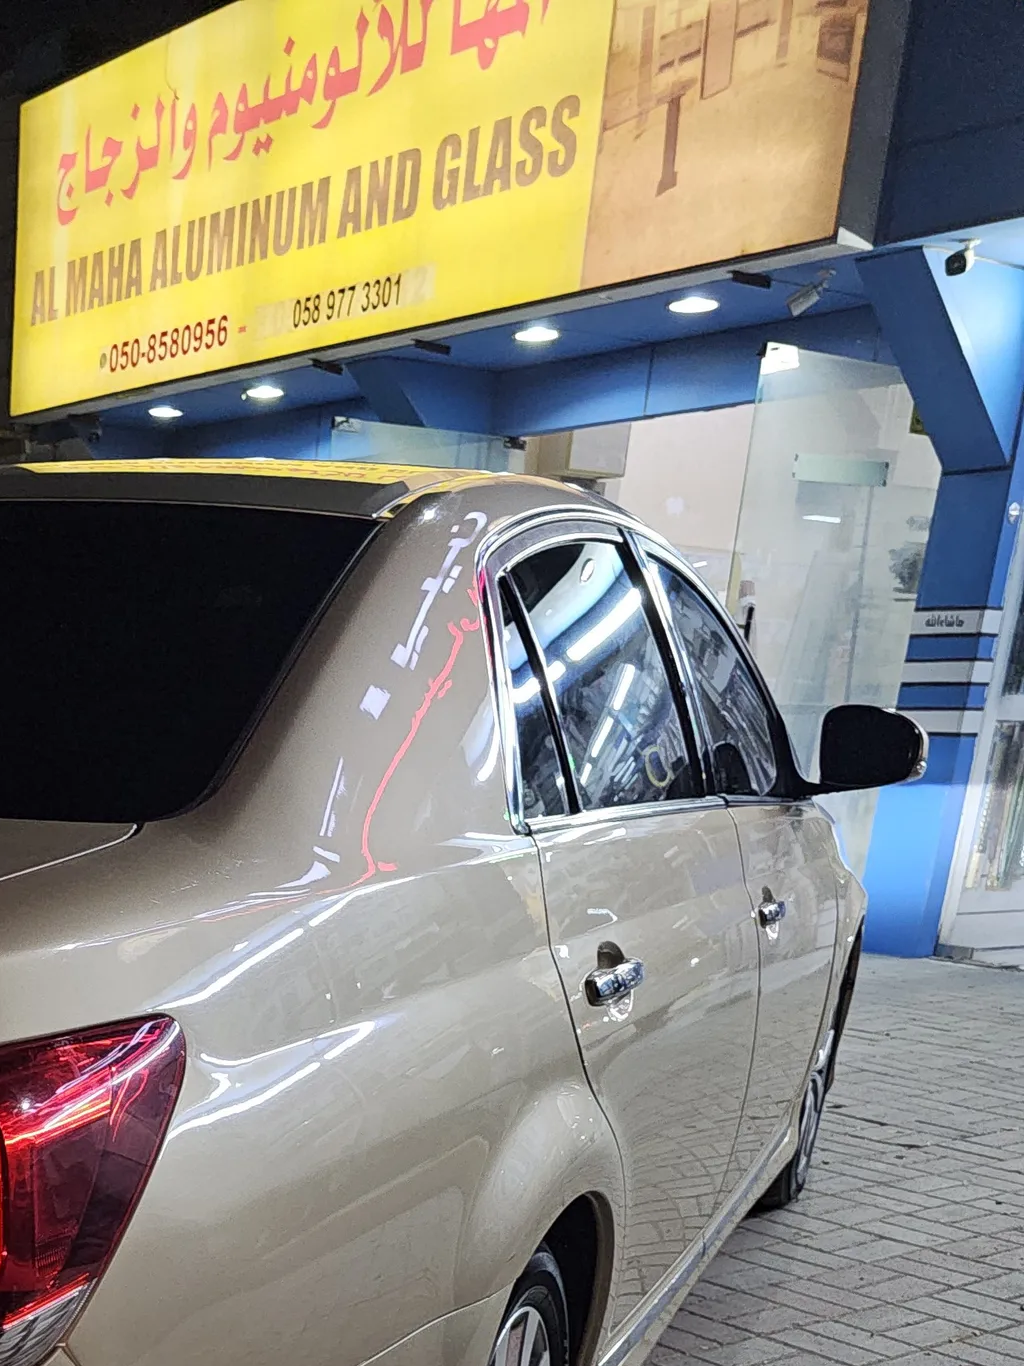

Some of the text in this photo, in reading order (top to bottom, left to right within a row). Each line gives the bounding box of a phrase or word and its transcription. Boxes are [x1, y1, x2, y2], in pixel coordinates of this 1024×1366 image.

[30, 94, 581, 327] AL MAHA ALUMINUM AND GLASS
[57, 92, 198, 226] والزجاج
[108, 314, 229, 374] 050-8580956
[292, 294, 321, 328] 058
[326, 285, 356, 320] 977
[361, 273, 402, 313] 3301
